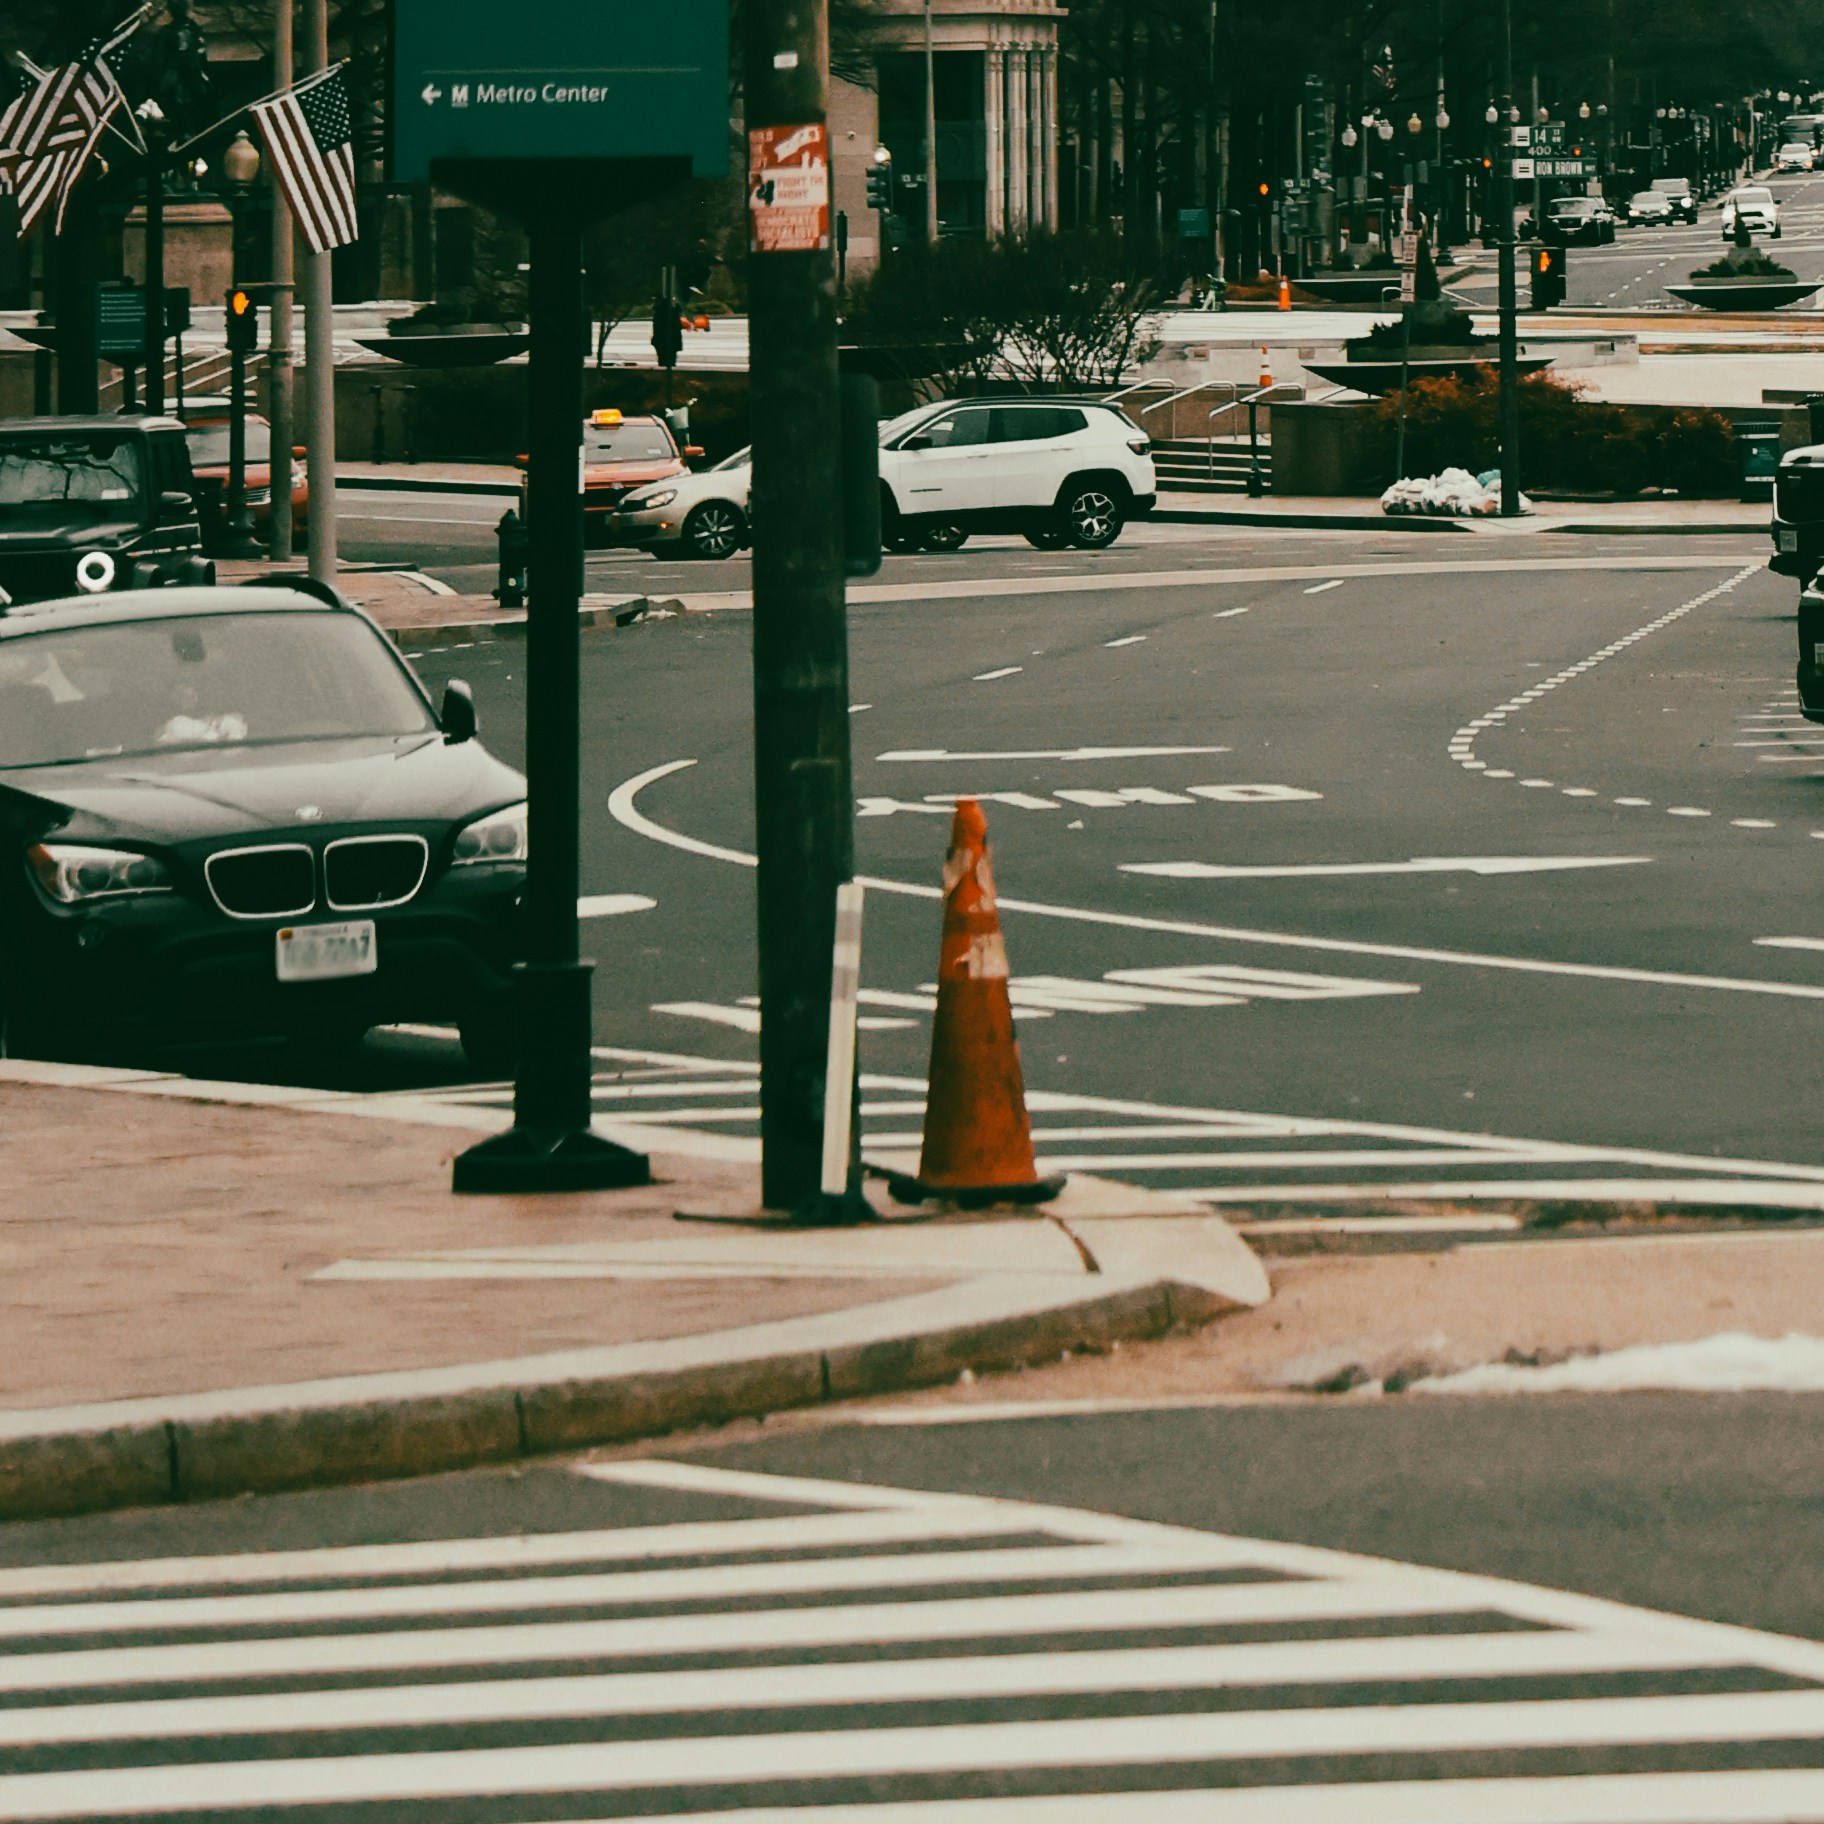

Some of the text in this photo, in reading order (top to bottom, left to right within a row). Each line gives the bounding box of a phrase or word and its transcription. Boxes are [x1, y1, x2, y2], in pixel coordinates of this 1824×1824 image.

[476, 83, 537, 103] Metro
[542, 83, 608, 103] Center
[1534, 128, 1547, 143] 14
[1528, 145, 1552, 156] 400
[1536, 161, 1553, 175] RON
[1555, 161, 1583, 175] BROWN
[856, 783, 1325, 819] ONLY
